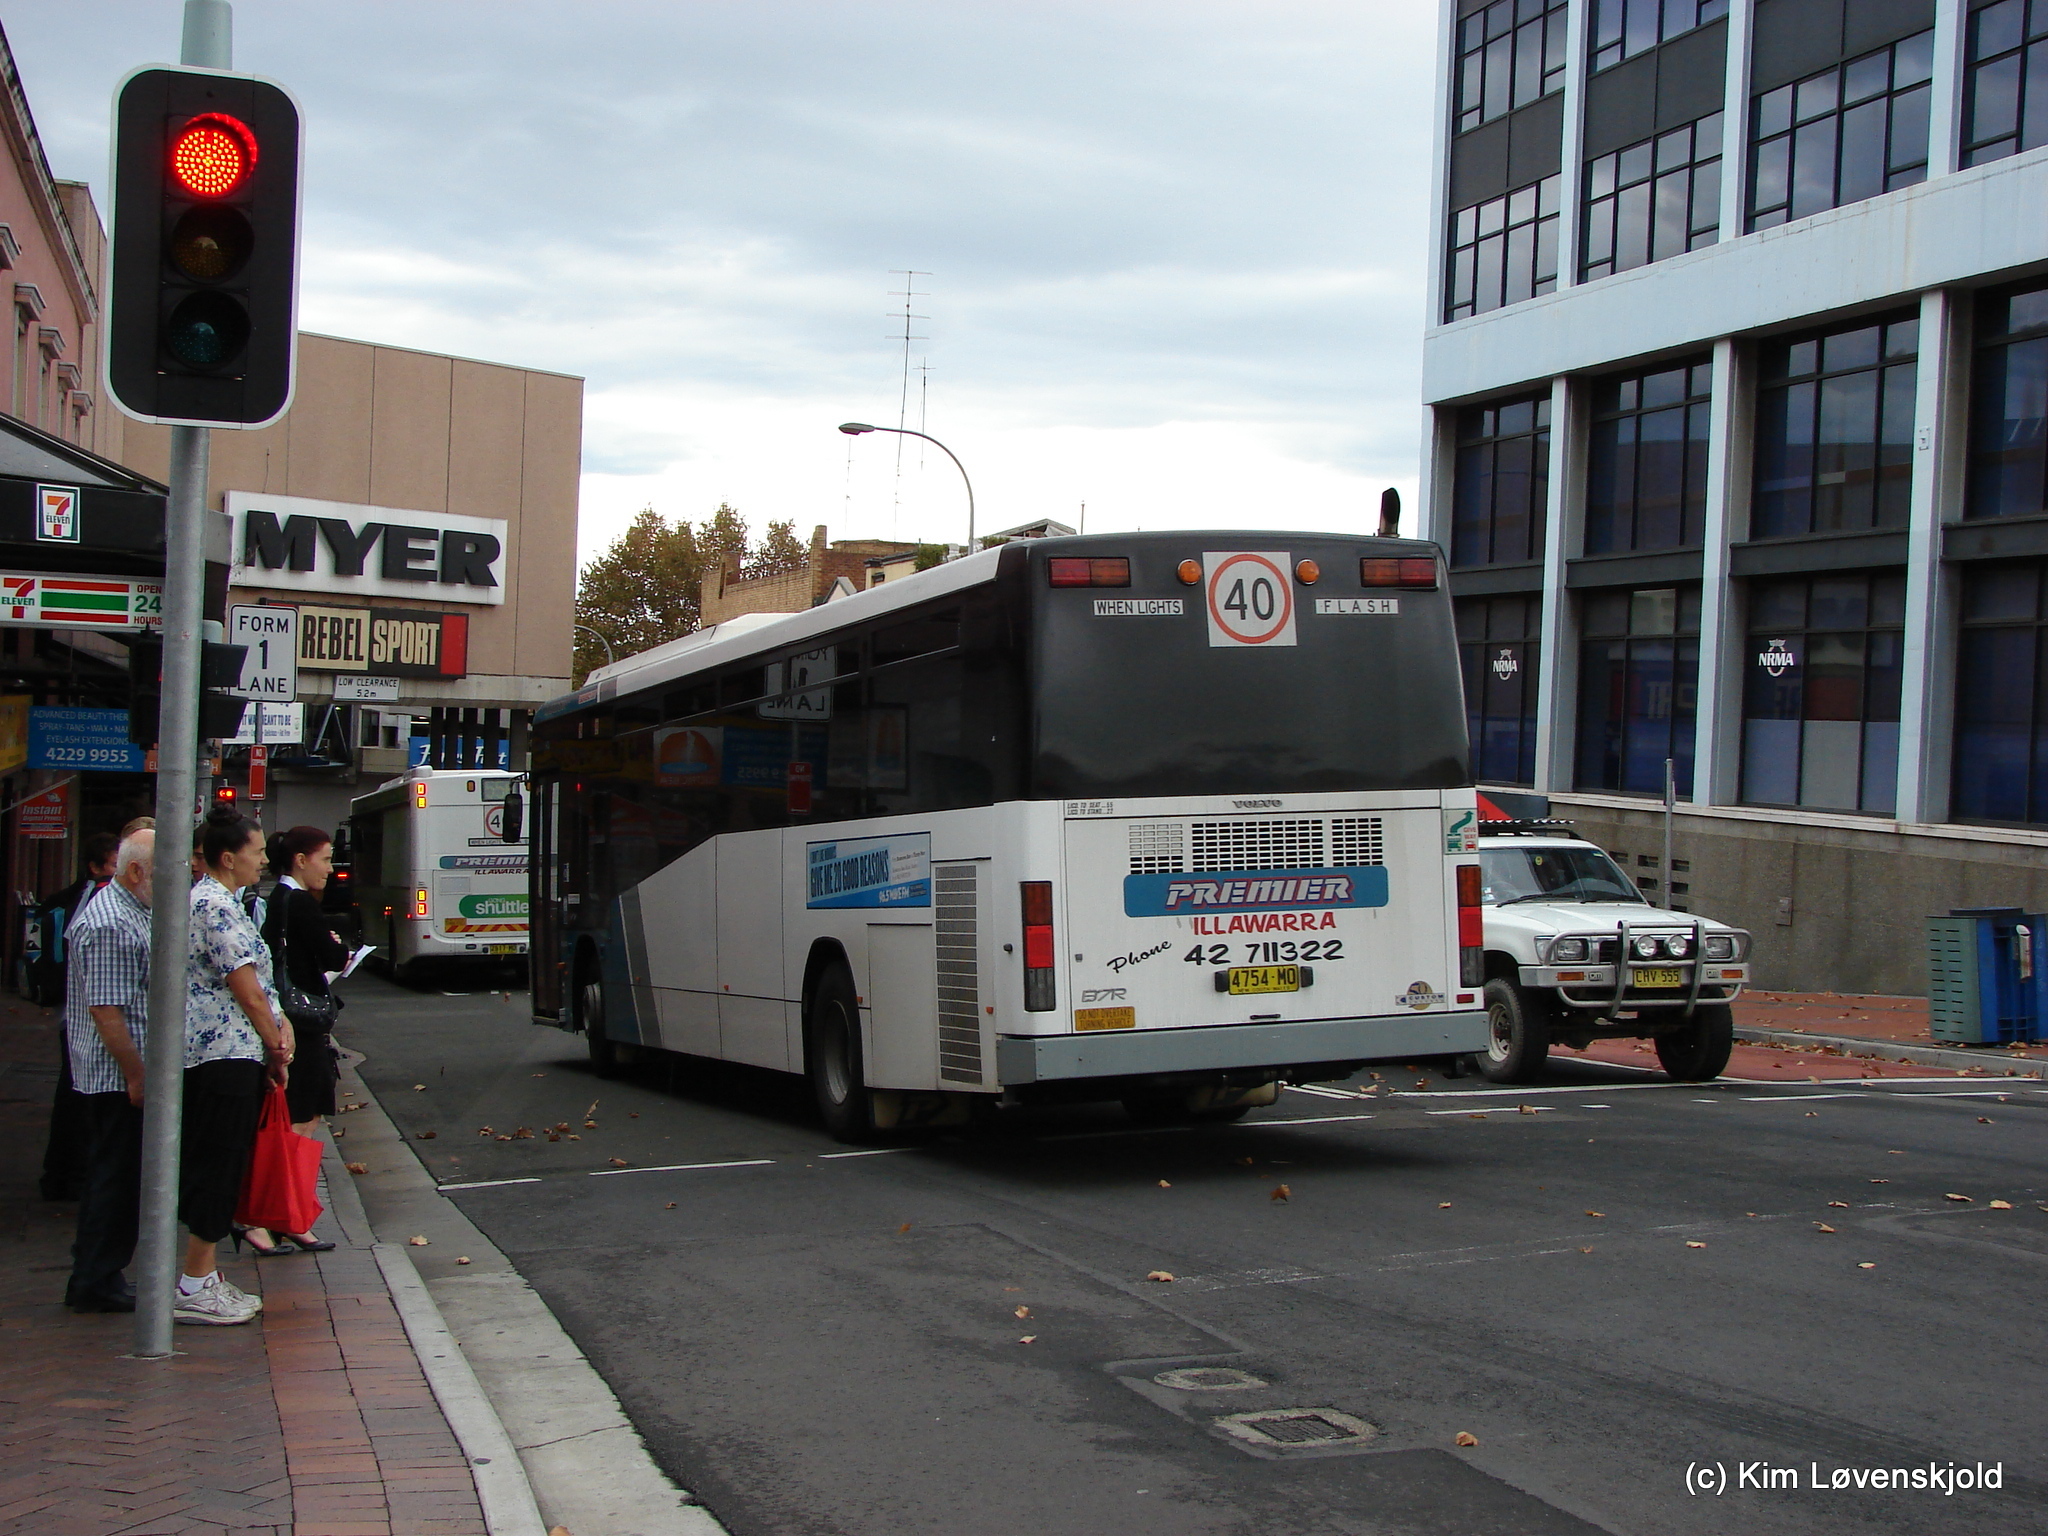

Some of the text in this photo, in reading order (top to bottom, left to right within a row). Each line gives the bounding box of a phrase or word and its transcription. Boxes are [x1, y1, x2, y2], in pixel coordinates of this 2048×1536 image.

[245, 510, 500, 587] MYER
[137, 584, 162, 594] OPEN
[135, 595, 162, 613] 24
[1223, 577, 1274, 621] 40
[1323, 599, 1391, 613] FLASH
[1096, 600, 1182, 615] WHEN LIGHTS
[134, 616, 163, 626] HOURS
[239, 615, 289, 633] FORM
[301, 614, 440, 666] REBEL SPORT
[258, 639, 268, 670] 1
[1759, 653, 1794, 667] NRMA
[1493, 660, 1517, 672] NRMA
[237, 678, 288, 693] LANE
[338, 677, 398, 688] LOW CLEARANCE
[356, 689, 377, 698] 5.2m
[33, 710, 76, 720] ADVANCED
[78, 711, 108, 721] BEAUTY
[91, 725, 108, 733] WAX
[46, 735, 129, 746] EYELASH EXTENSIONS
[46, 747, 129, 763] 4229 9955
[1231, 798, 1283, 808] VOLVO
[474, 868, 529, 876] ILLAWARRA
[1164, 875, 1355, 910] PREMIER
[475, 900, 529, 914] shuttle
[1193, 912, 1337, 936] ILLAWARRA
[1106, 939, 1345, 974] Phone 42 711322
